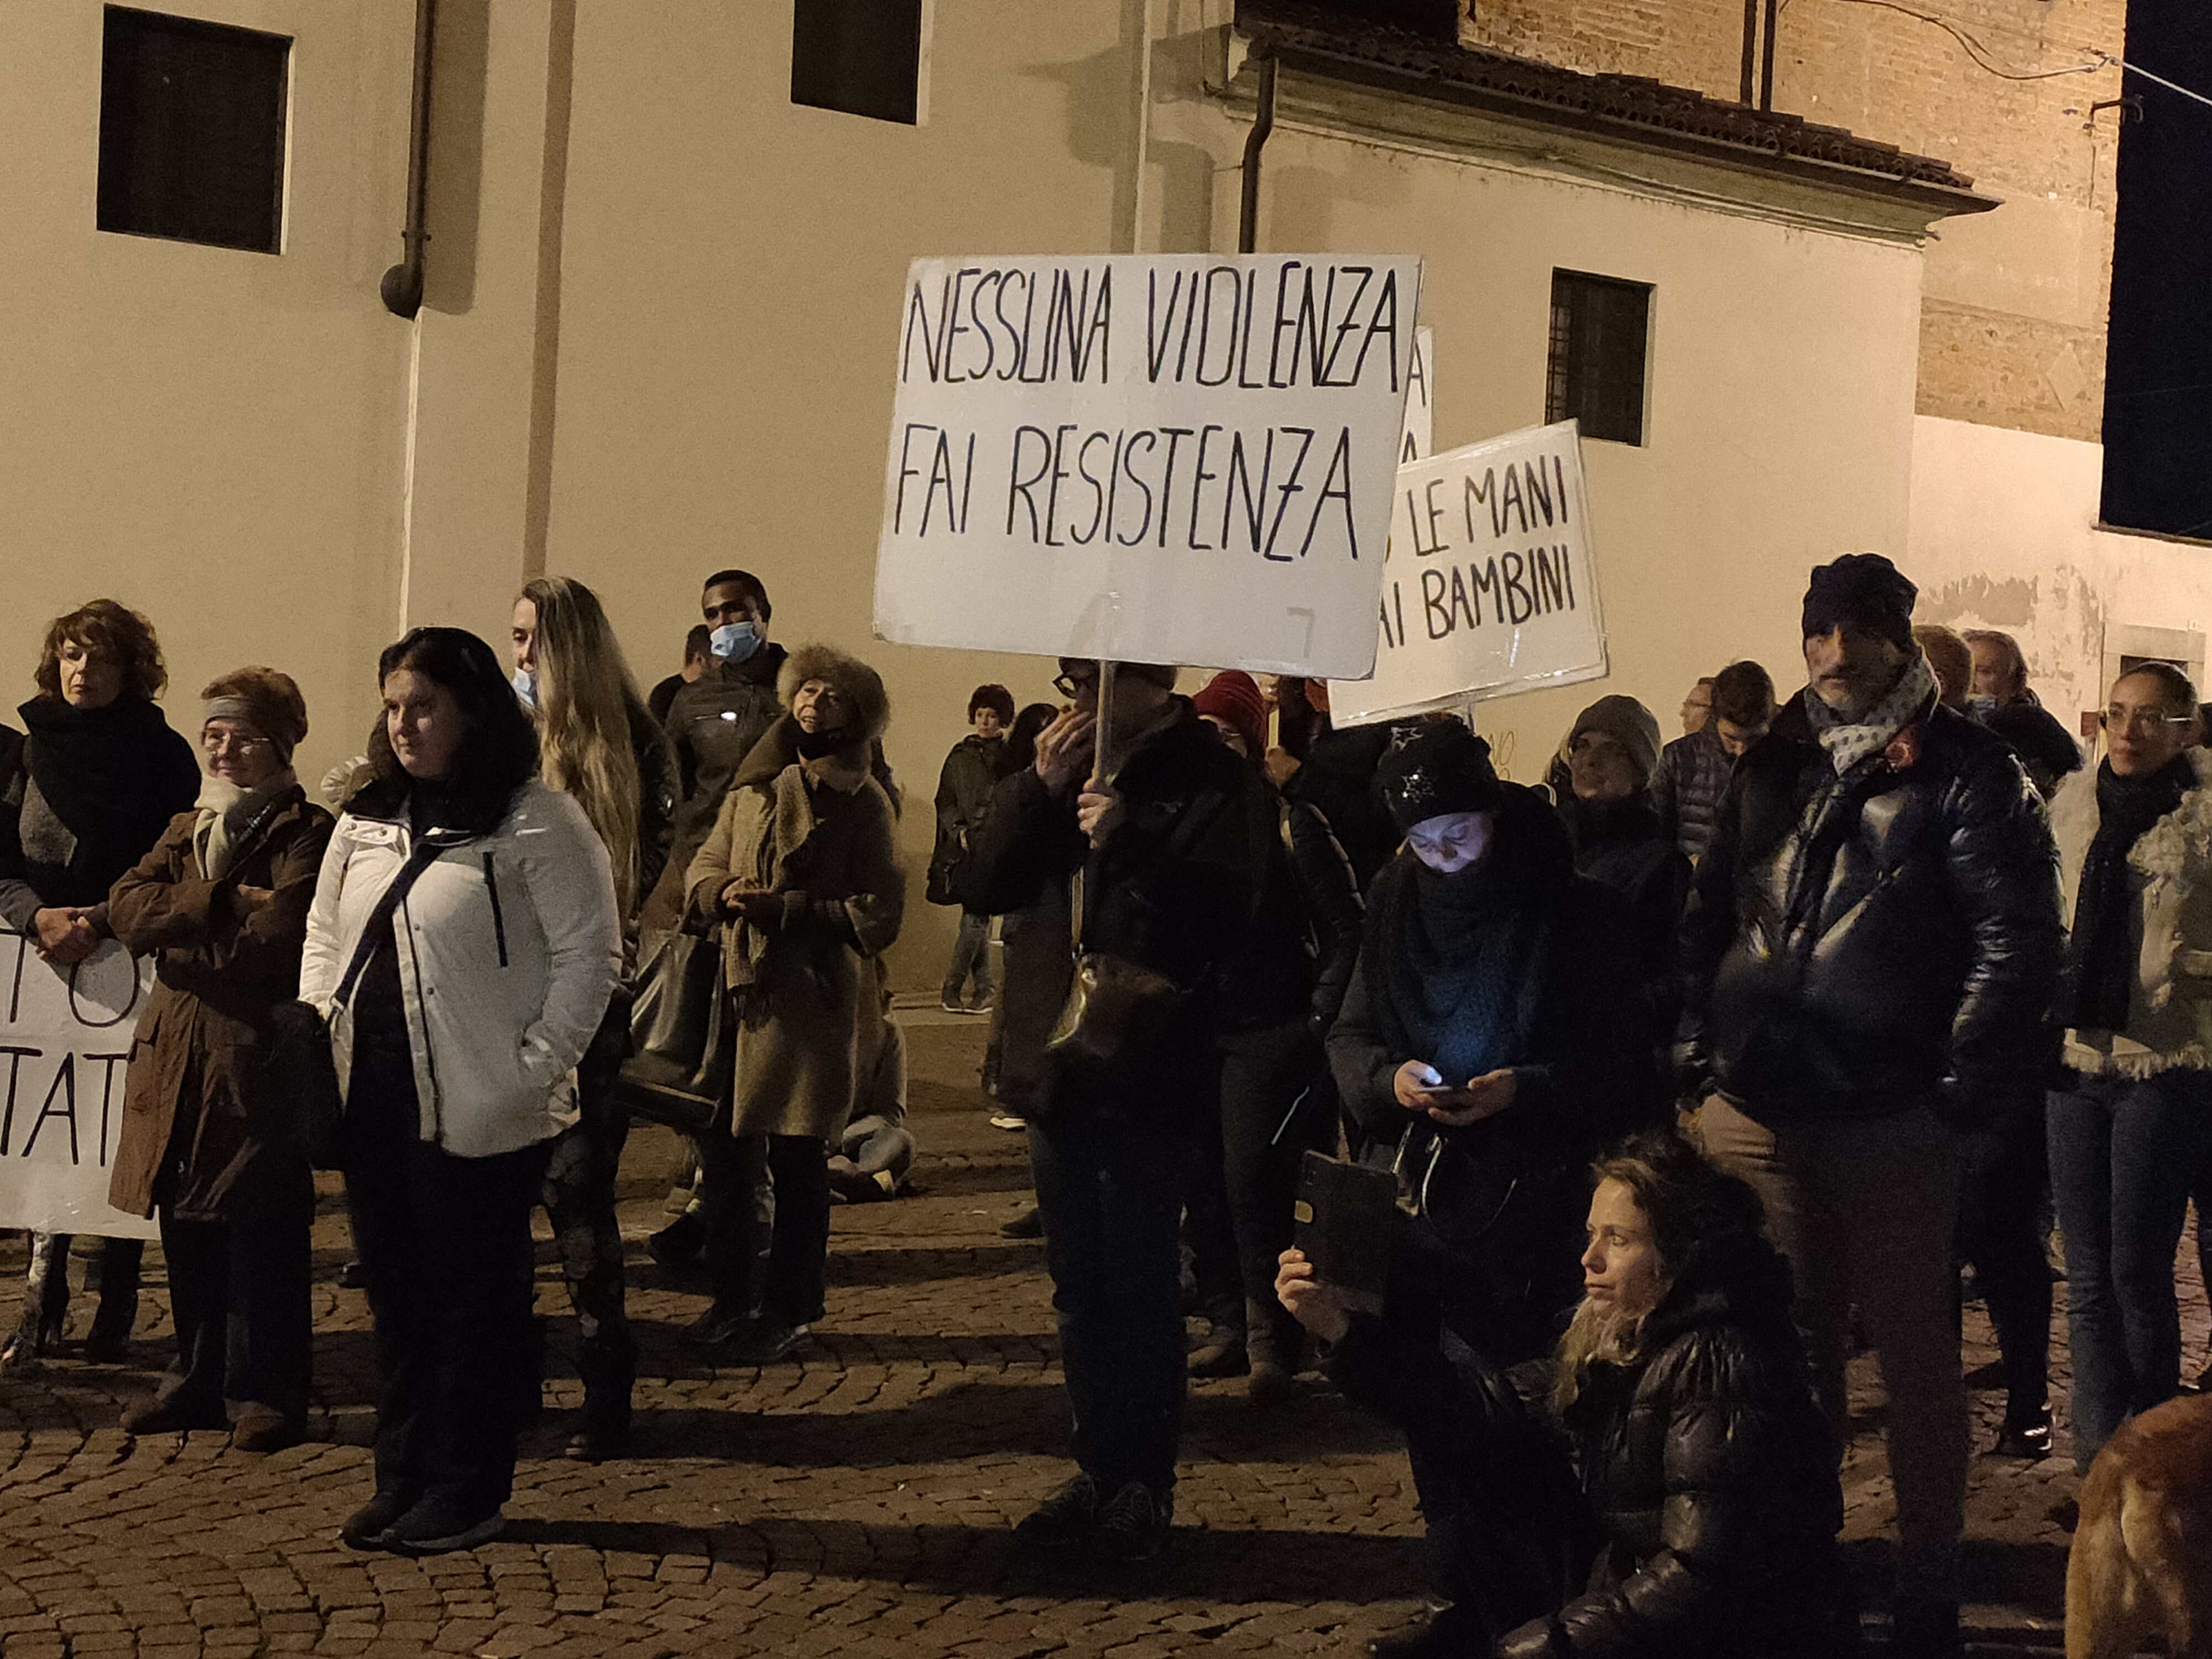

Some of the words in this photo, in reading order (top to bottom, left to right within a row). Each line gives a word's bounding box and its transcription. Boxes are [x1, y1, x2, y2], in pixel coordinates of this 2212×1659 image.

[902, 263, 1112, 385] NESSUNA
[1147, 260, 1399, 394] VIOLENZA
[894, 422, 975, 539] FAI
[1006, 423, 1359, 563] RESISTENZA
[1406, 478, 1451, 557] LE
[1464, 454, 1568, 544] MANI
[1421, 544, 1576, 641] BAMBINI
